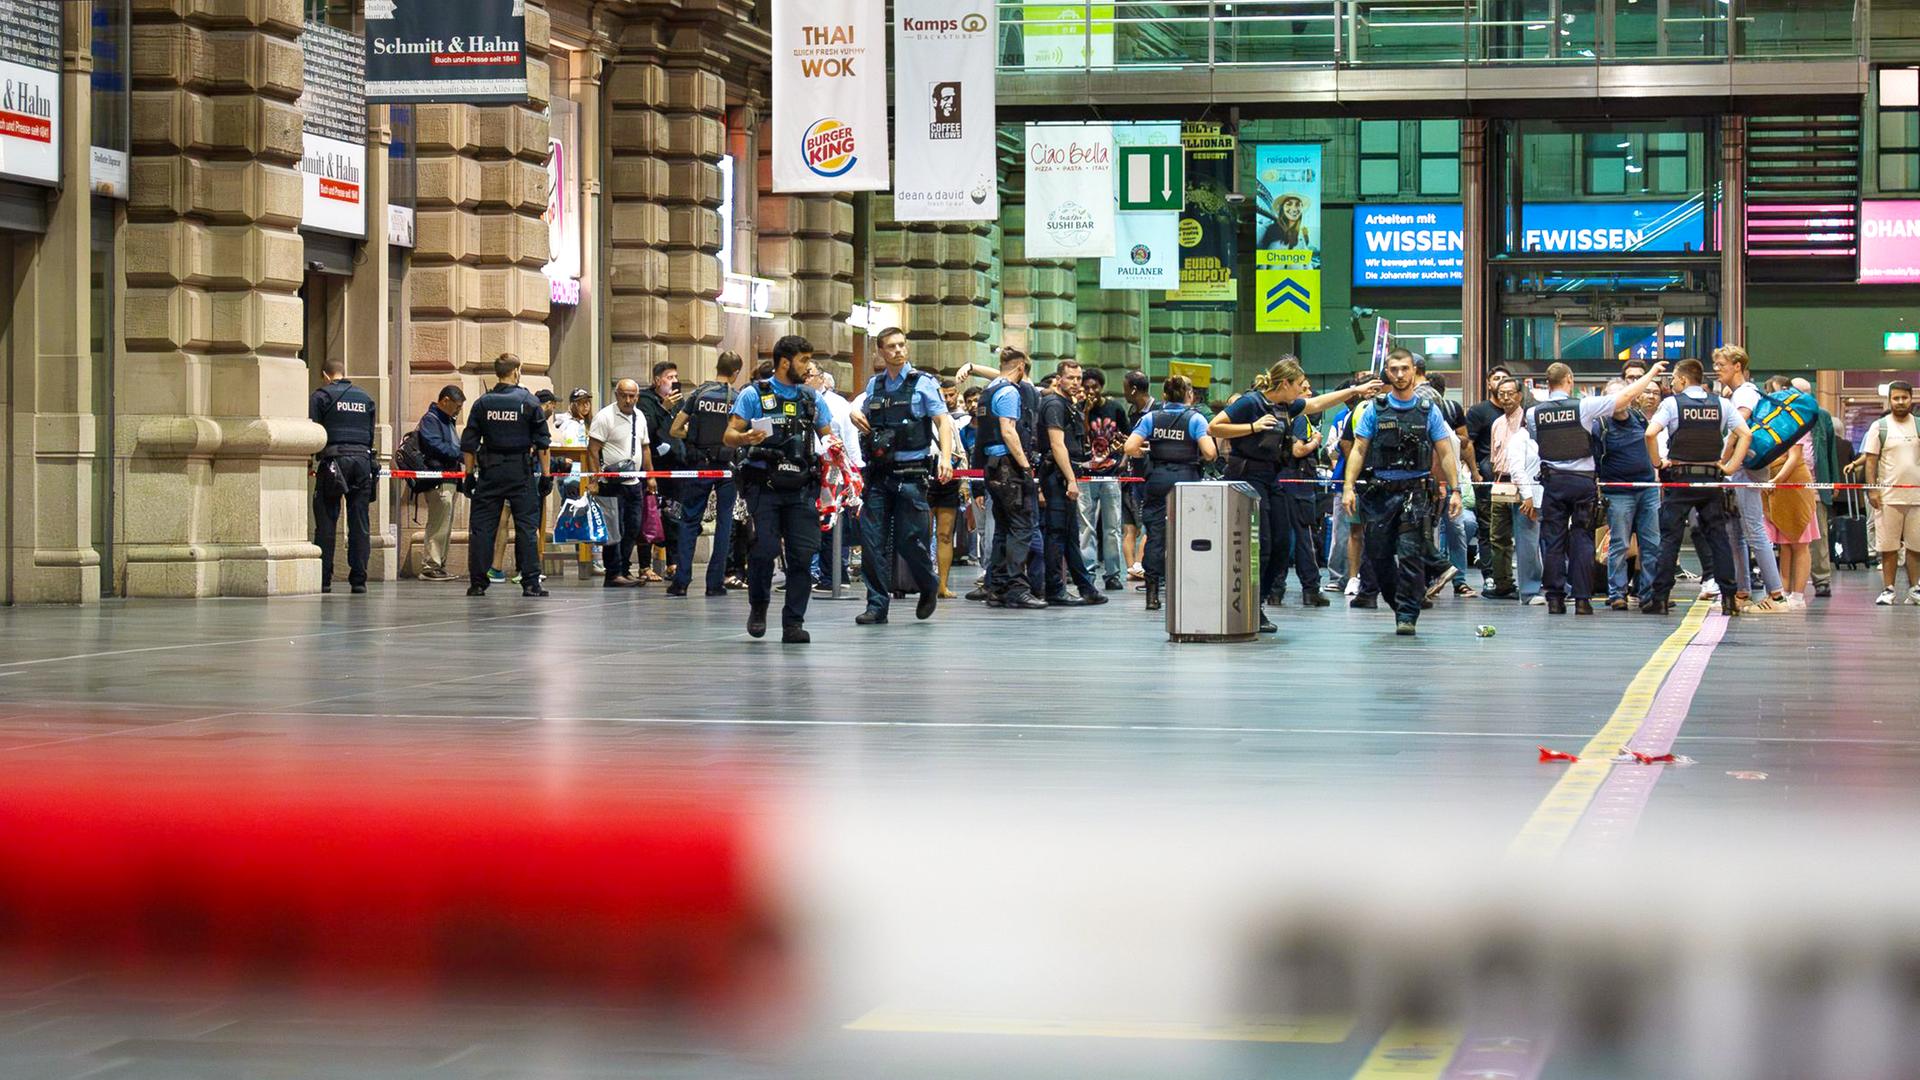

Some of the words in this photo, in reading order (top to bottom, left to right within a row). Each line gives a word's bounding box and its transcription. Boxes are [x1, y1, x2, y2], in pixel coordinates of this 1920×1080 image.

[903, 17, 958, 34] Kamps
[802, 25, 855, 45] THAI
[373, 37, 444, 54] Schmitt
[448, 36, 464, 52] &
[468, 36, 520, 52] Hahn
[816, 48, 838, 56] FRESH
[840, 47, 865, 55] YUMMY
[434, 56, 452, 64] Buch
[466, 55, 489, 63] Presse
[801, 57, 856, 78] WOK
[4, 78, 15, 111] &
[18, 81, 51, 118] Hahn
[930, 122, 961, 133] COFFEE
[807, 127, 853, 150] BURGER
[809, 137, 855, 166] KING
[1030, 142, 1065, 165] Ciao
[1069, 141, 1109, 164] Bella
[1266, 155, 1311, 164] reisebank
[327, 152, 334, 178] &
[336, 154, 359, 183] Hahn
[898, 190, 924, 200] dean
[927, 191, 933, 200] &
[935, 190, 964, 200] david
[1365, 213, 1414, 225] Arbeiten
[1416, 213, 1436, 224] mit
[1046, 221, 1074, 230] SUSHI
[1076, 221, 1094, 230] BAR
[1365, 230, 1464, 252] WISSEN
[1266, 251, 1306, 263] Change
[1365, 258, 1380, 267] Wir
[1381, 258, 1418, 268] bewegen
[1437, 257, 1455, 266] weil
[1184, 257, 1215, 270] EURO
[1117, 267, 1163, 276] PAULANER
[1180, 268, 1227, 281] ACKPOT
[1365, 271, 1378, 279] Die
[1379, 271, 1420, 280] Johanniter
[1421, 271, 1448, 279] suchen
[1450, 271, 1463, 279] Mit
[336, 401, 366, 413] POLIZEI
[698, 400, 728, 414] POLIZ
[486, 410, 518, 421] POLIZEI
[1538, 409, 1576, 424] POLIZEI
[1683, 408, 1720, 420] POLIZEI
[1379, 421, 1396, 430] POLIZEI
[1153, 427, 1185, 441] POLIZEI
[778, 463, 801, 472] POLIZEI
[1232, 531, 1242, 614] Abfall
